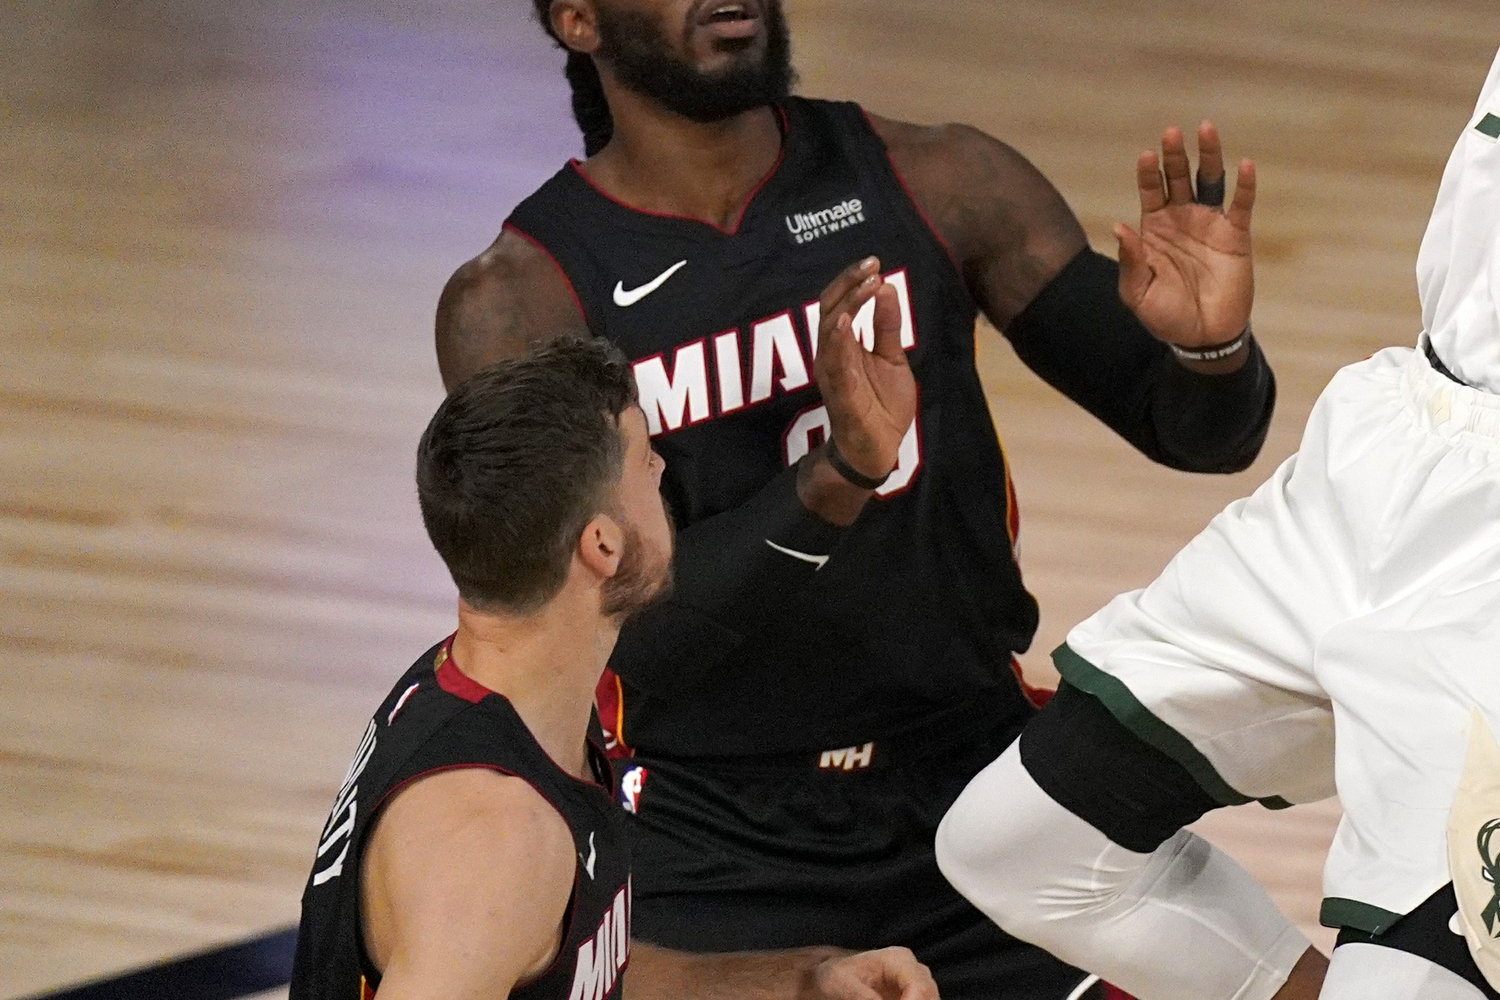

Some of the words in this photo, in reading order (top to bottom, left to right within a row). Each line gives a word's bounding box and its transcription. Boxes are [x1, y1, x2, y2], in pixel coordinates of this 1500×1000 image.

[785, 199, 862, 234] Ultimate
[795, 211, 865, 244] SOFTWARE
[567, 872, 632, 1000] MIA
